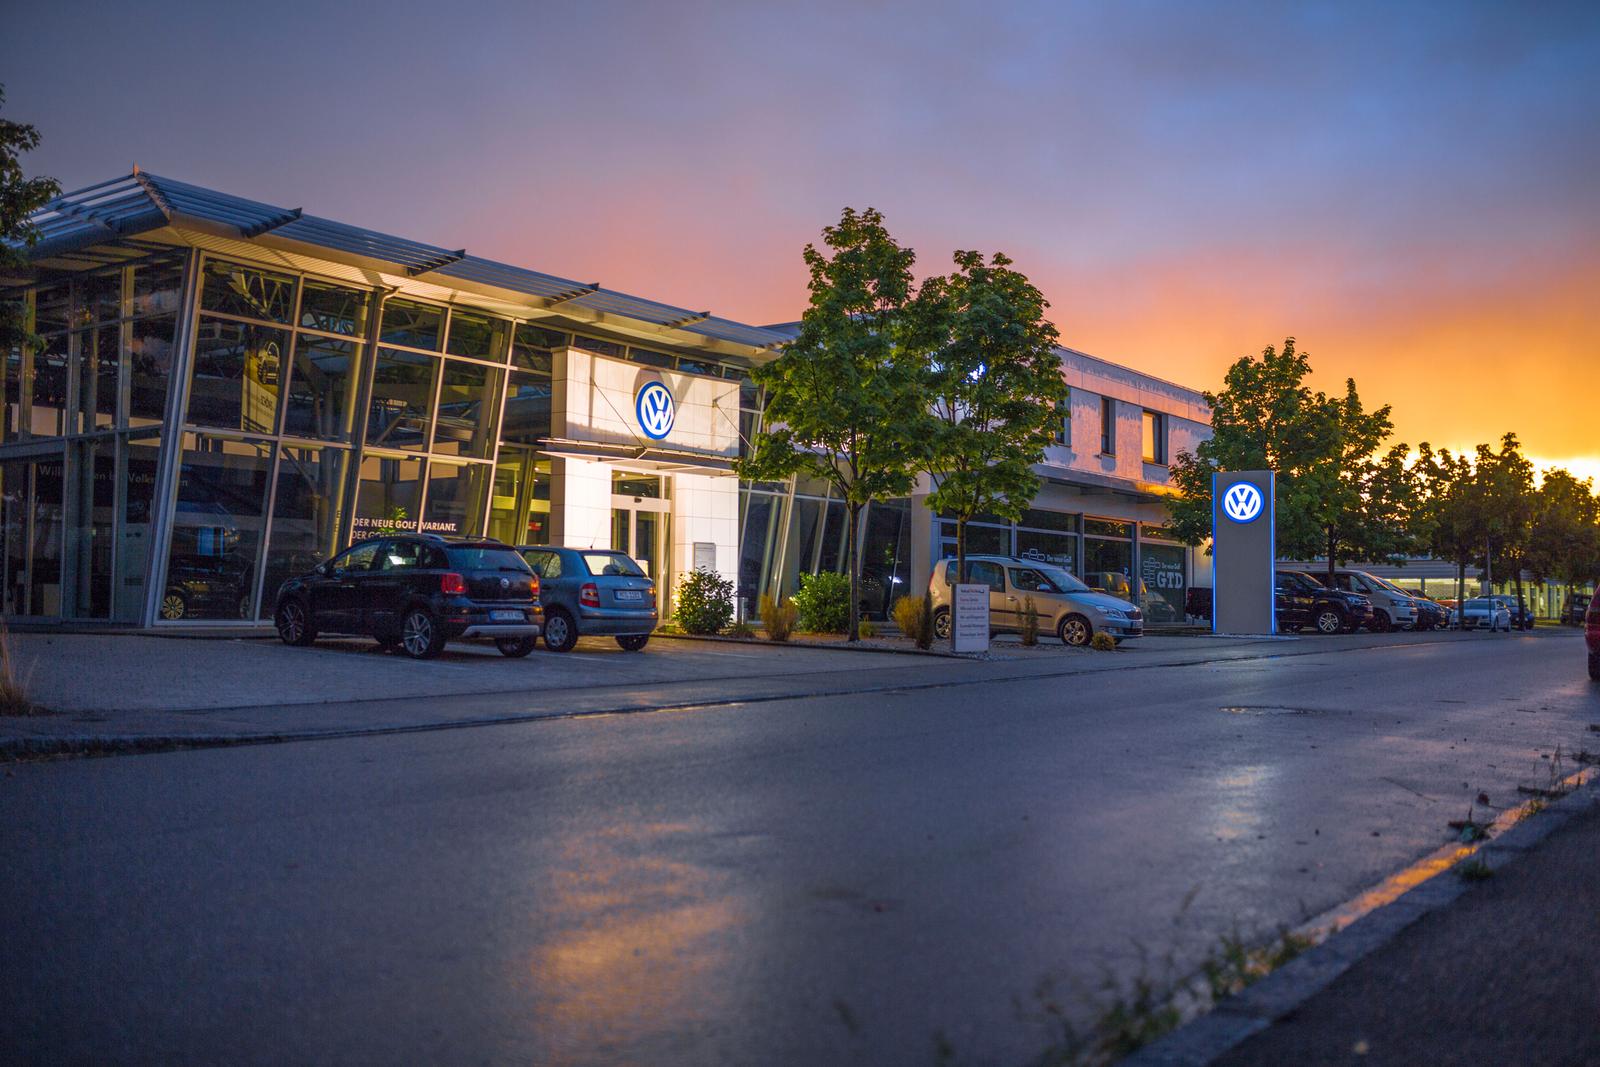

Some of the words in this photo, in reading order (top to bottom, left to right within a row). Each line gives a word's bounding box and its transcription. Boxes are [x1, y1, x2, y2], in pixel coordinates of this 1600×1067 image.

[638, 383, 674, 437] VW
[1224, 483, 1262, 521] VW
[354, 518, 369, 527] DER
[371, 519, 394, 528] NEUE
[395, 520, 417, 529] GOLF
[421, 521, 457, 531] VARIANT.
[1157, 571, 1183, 589] GTD
